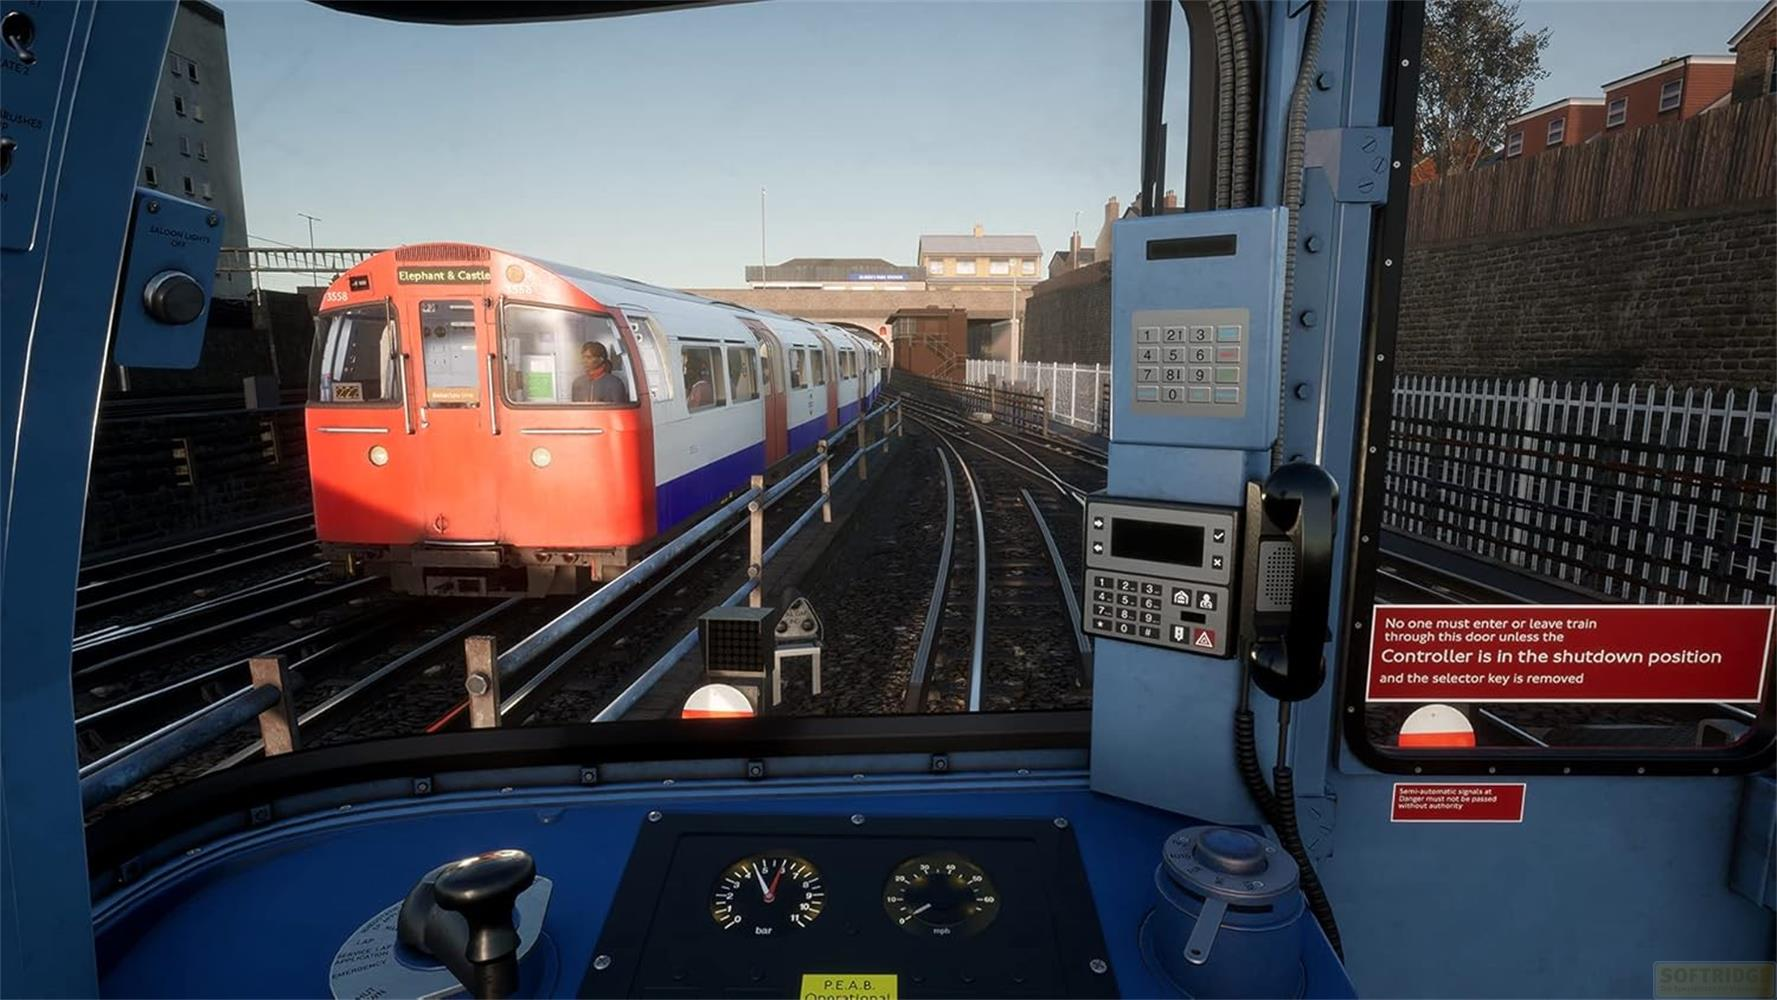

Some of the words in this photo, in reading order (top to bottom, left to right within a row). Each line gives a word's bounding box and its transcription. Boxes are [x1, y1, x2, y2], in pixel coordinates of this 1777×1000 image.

[398, 271, 445, 283] Elephant
[447, 271, 456, 281] &
[457, 270, 492, 281] Castle
[325, 291, 350, 302] 3558
[1144, 330, 1150, 341] 1
[1196, 329, 1206, 341] 3
[1143, 350, 1152, 361] 4
[1169, 349, 1178, 361] 5
[1196, 349, 1205, 361] 6
[1143, 369, 1152, 381] 7
[1195, 369, 1205, 382] 9
[1168, 389, 1177, 401] 0
[1099, 578, 1105, 587] 1
[1122, 580, 1129, 590] 2
[1145, 584, 1153, 594] 3
[1098, 592, 1105, 601] 4
[1121, 595, 1129, 605] 5
[1145, 599, 1153, 608] 6
[1098, 605, 1105, 614] 7
[1121, 609, 1128, 619] 8
[1145, 613, 1153, 623] 9
[1120, 623, 1128, 633] 0
[1384, 618, 1405, 629] No
[1407, 620, 1433, 629] one
[1436, 618, 1470, 629] must
[1472, 618, 1508, 629] enter
[1511, 620, 1527, 629] or
[1529, 618, 1563, 629] leave
[1566, 618, 1597, 629] train
[1384, 631, 1435, 644] through
[1438, 631, 1463, 642] this
[1465, 631, 1496, 642] door
[1498, 631, 1540, 642] unless
[1542, 631, 1564, 642] the
[1380, 648, 1474, 664] Controller
[1477, 649, 1493, 664] is
[1497, 649, 1513, 664] in
[1517, 649, 1548, 664] the
[1553, 649, 1643, 664] shutdown
[1648, 649, 1722, 667] position
[1379, 673, 1404, 684] and
[1407, 673, 1430, 684] the
[1432, 673, 1486, 684] selector
[1487, 673, 1510, 686] key
[1513, 673, 1524, 684] is
[1526, 673, 1585, 684] removed
[1399, 788, 1457, 796] Semi-automatic
[1457, 788, 1483, 797] signals
[1398, 795, 1425, 803] Danger
[1460, 795, 1471, 803] be
[1471, 795, 1498, 804] passed
[1398, 802, 1428, 810] without
[1428, 803, 1464, 811] authority
[919, 863, 930, 871] 30
[945, 863, 957, 871] 40
[894, 874, 906, 883] 20
[971, 874, 983, 882] 50
[733, 881, 741, 889] 3
[726, 892, 734, 900] 2
[805, 892, 813, 900] 9
[887, 896, 897, 904] 10
[983, 896, 996, 904] 60
[726, 905, 732, 913] 1
[799, 903, 810, 911] 10
[734, 915, 742, 923] 0
[790, 914, 800, 922] 11
[898, 917, 906, 925] 0
[754, 926, 773, 935] bar
[932, 927, 951, 936] mph
[332, 958, 387, 979] EMERGENCY
[824, 979, 876, 991] P.E.A.B.
